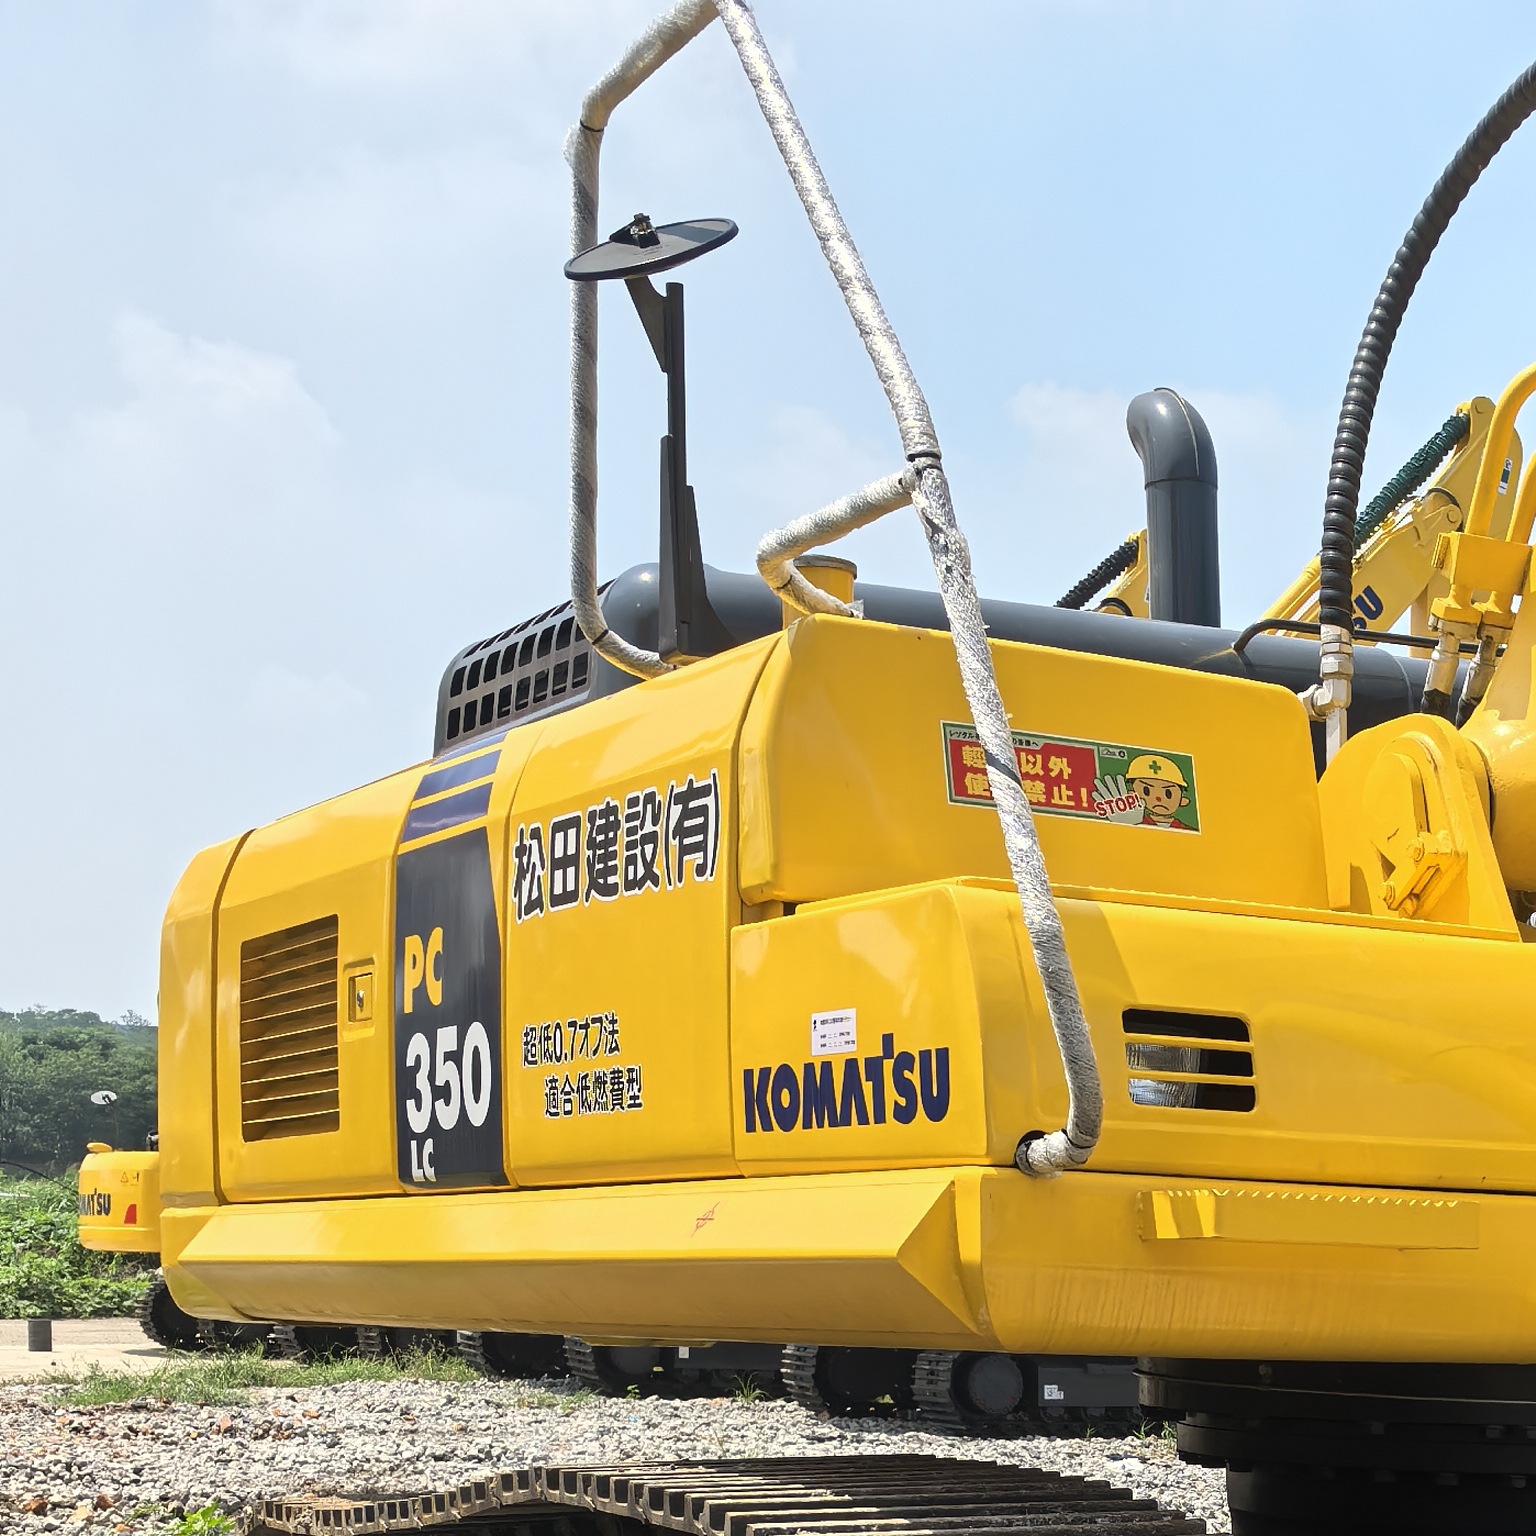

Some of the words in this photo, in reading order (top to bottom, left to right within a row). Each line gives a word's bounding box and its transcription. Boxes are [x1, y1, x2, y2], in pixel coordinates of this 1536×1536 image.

[513, 773, 720, 920] 松田建設(有)
[1096, 794, 1142, 817] STOP!
[403, 926, 443, 1014] PC
[406, 1021, 492, 1134] 350
[545, 1065, 643, 1117] 適合低燃費型
[743, 1033, 949, 1133] KOMATSU
[410, 1138, 437, 1182] LC
